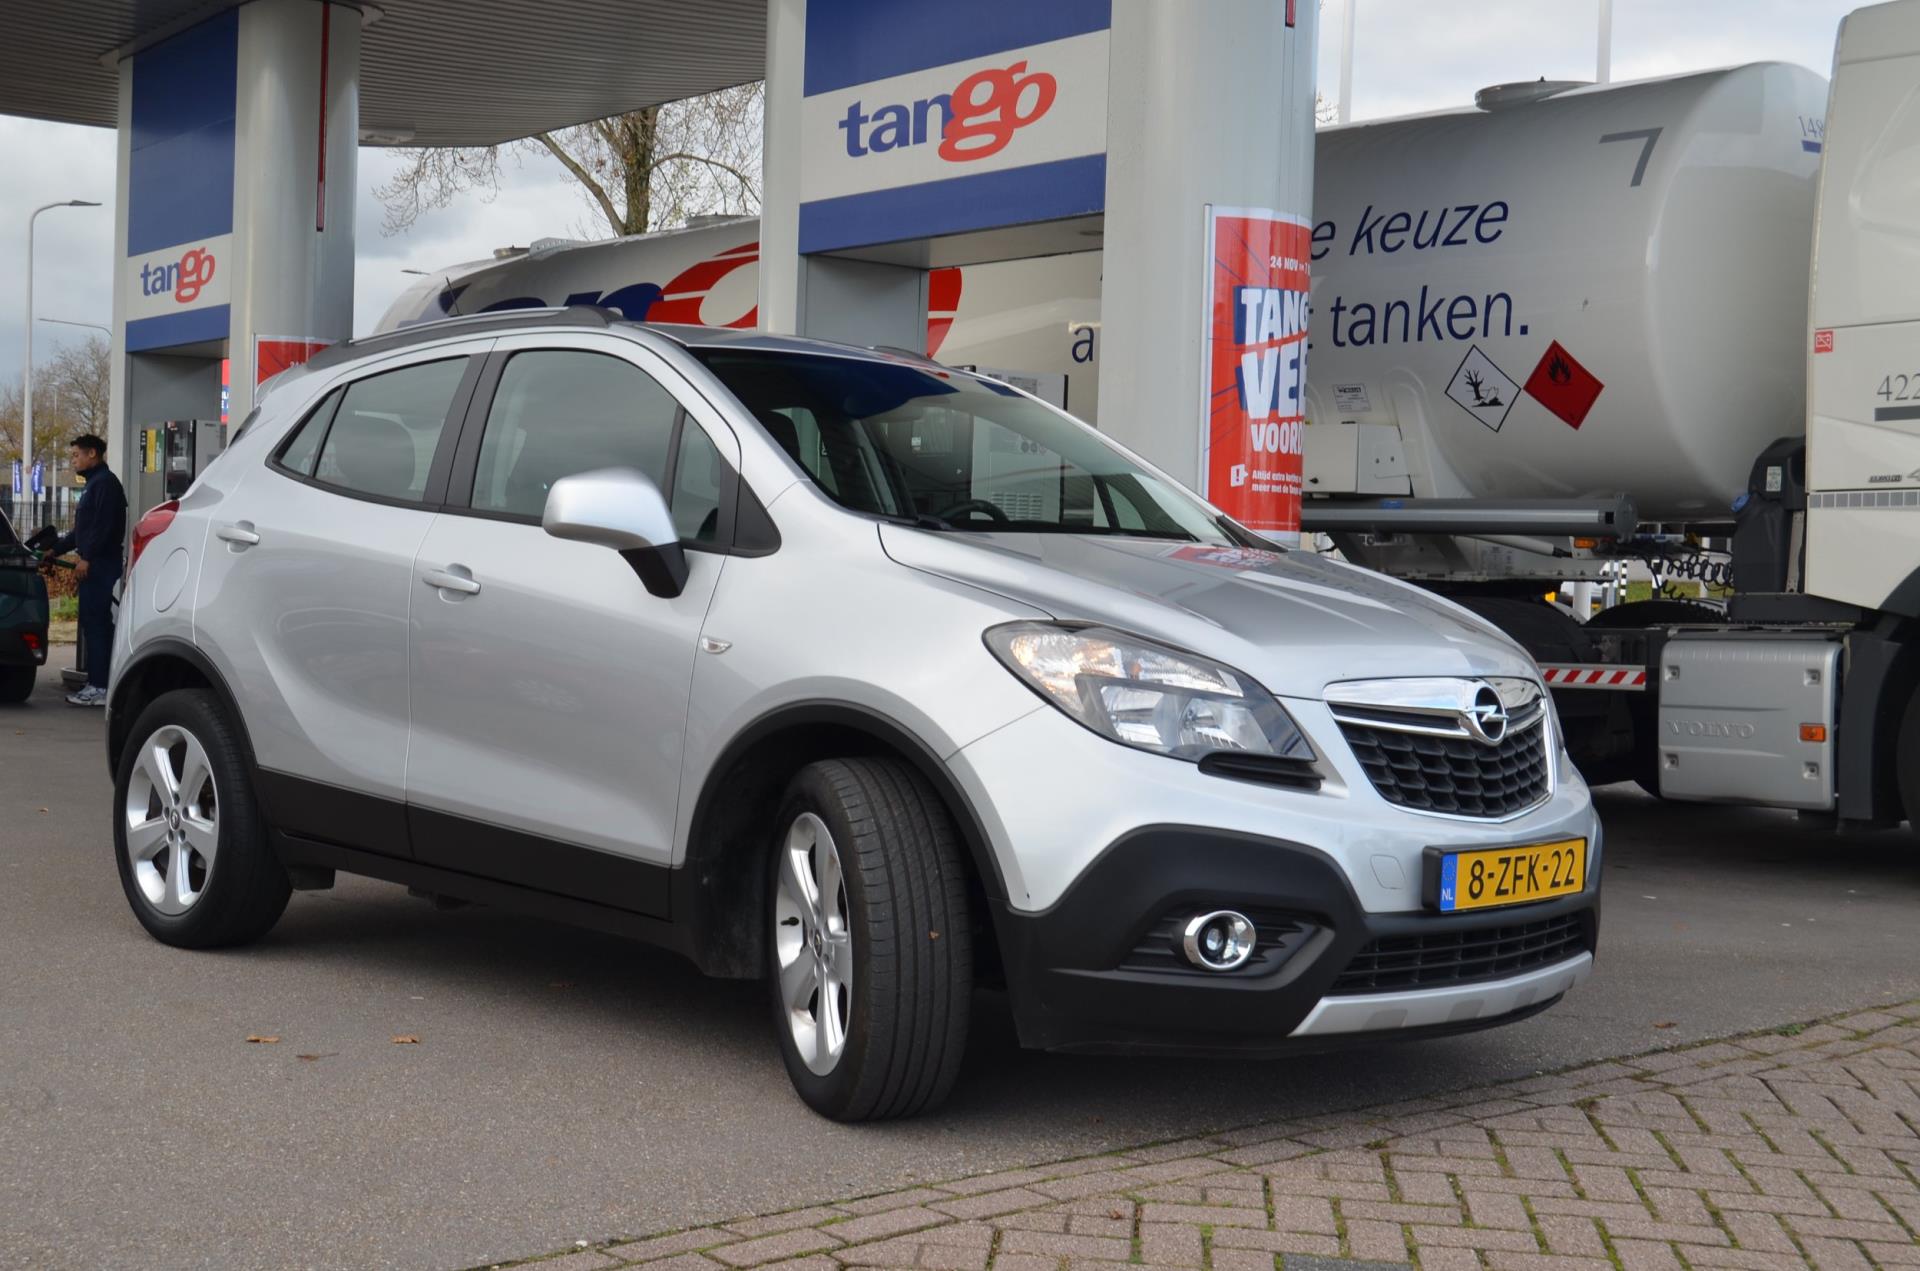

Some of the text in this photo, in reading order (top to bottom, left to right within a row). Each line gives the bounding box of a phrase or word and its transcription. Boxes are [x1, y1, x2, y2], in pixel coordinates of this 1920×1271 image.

[838, 60, 1058, 162] tango
[1350, 200, 1509, 256] keuze
[140, 246, 216, 304] tango
[1270, 255, 1282, 270] 24
[1284, 257, 1299, 272] NOV
[1330, 285, 1529, 347] tanken.
[1665, 719, 1756, 739] VOLVO
[1442, 888, 1453, 901] NL
[1468, 848, 1575, 899] 8-ZFK-22
